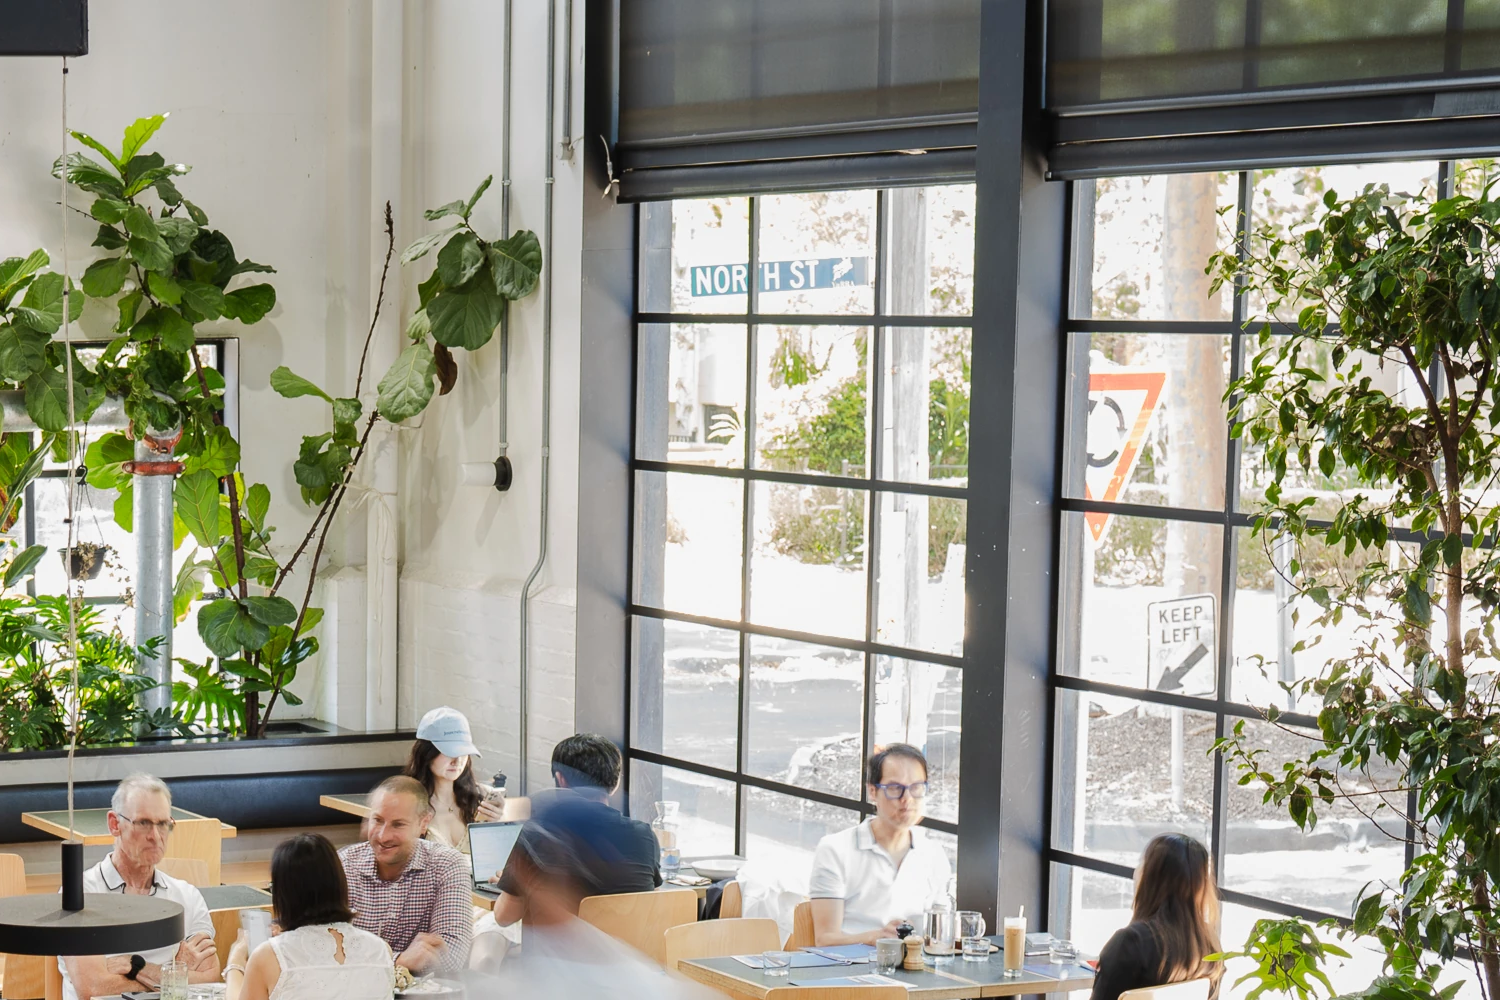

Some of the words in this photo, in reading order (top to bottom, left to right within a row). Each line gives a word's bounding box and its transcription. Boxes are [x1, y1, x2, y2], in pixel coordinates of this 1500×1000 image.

[695, 263, 780, 295] NORH
[789, 260, 820, 290] ST
[1159, 606, 1202, 623] KEEP
[1162, 627, 1201, 644] LEFT
